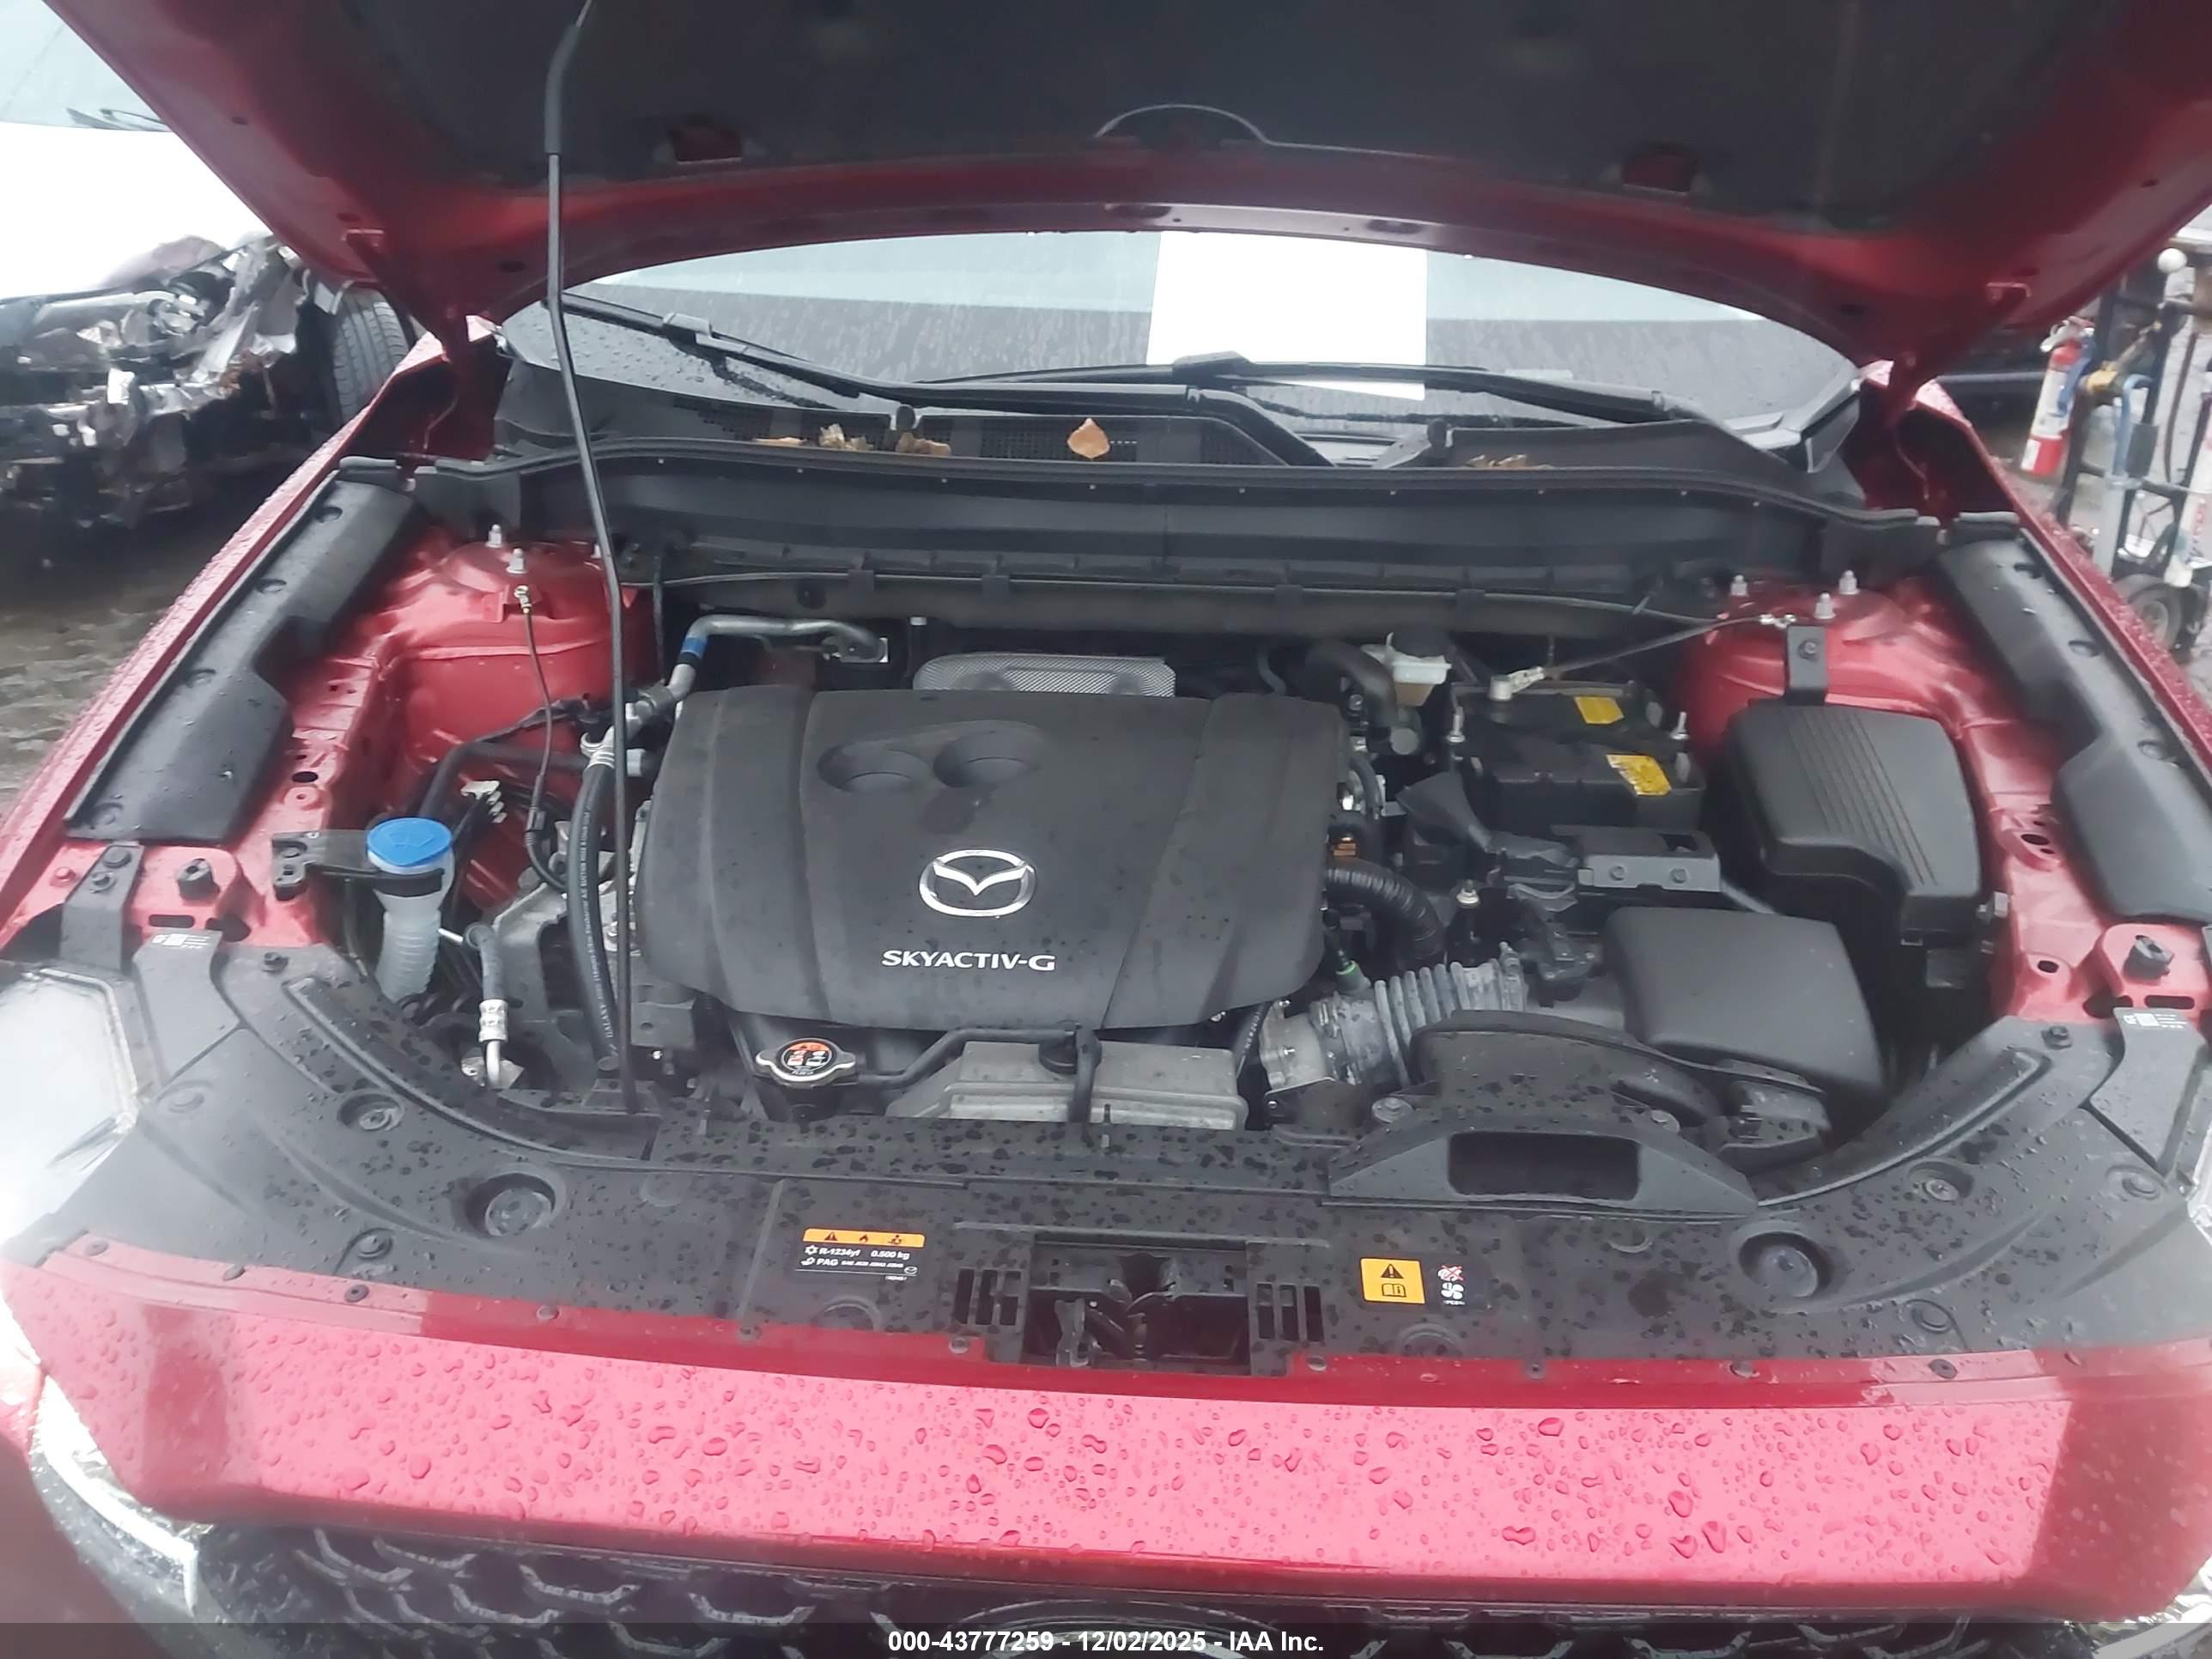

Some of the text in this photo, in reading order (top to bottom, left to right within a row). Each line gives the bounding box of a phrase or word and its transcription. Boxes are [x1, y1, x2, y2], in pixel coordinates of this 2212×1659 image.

[881, 949, 1057, 972] SKYACTIV-G
[870, 1249, 897, 1258] 0.500
[896, 1251, 910, 1261] kg
[816, 1257, 839, 1267] PAG
